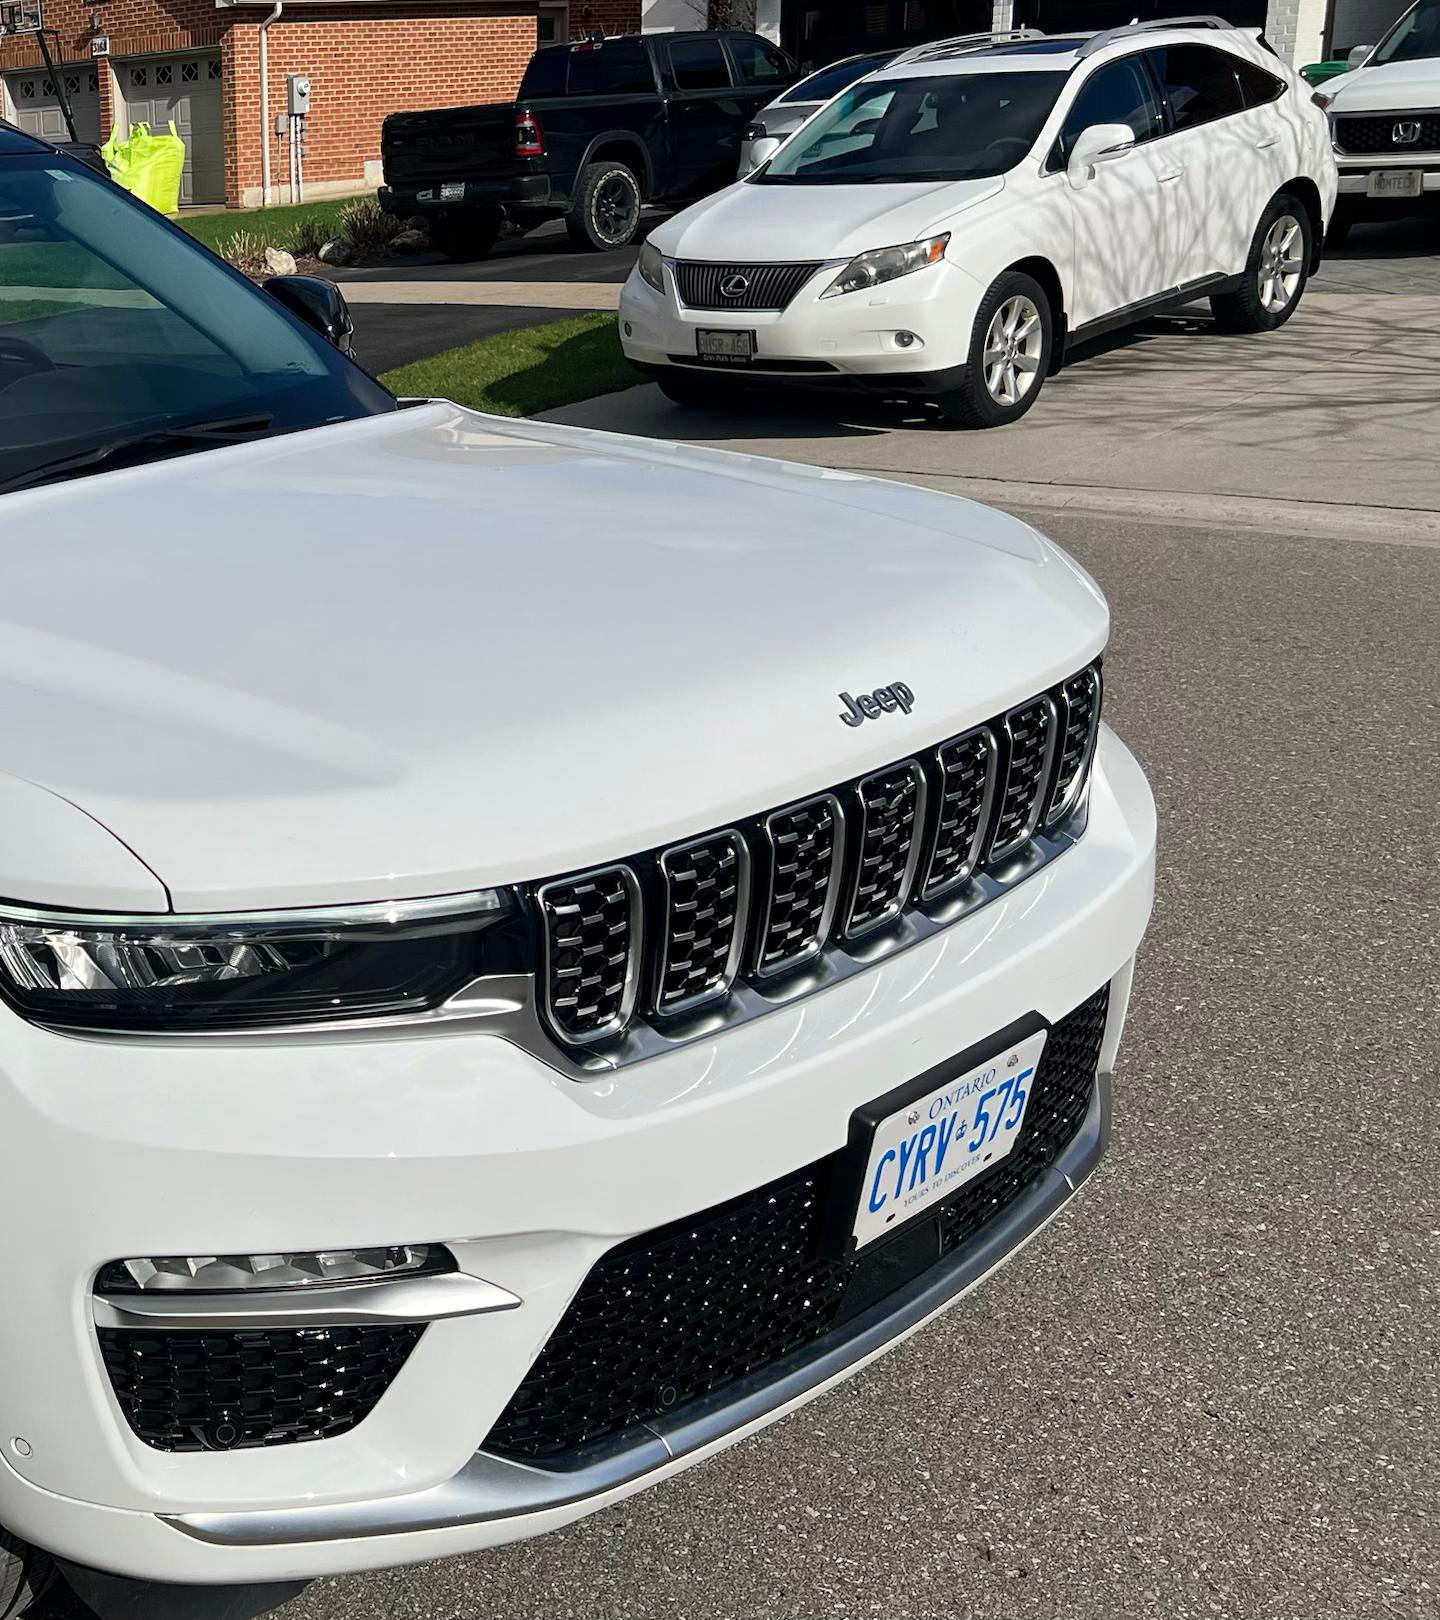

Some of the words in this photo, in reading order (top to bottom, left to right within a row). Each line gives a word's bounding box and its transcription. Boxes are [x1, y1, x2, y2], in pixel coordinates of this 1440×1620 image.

[838, 681, 915, 727] Jeep
[929, 1068, 996, 1119] ONTARIO
[869, 1111, 958, 1213] CYRV
[969, 1067, 1034, 1153] 575
[903, 1187, 929, 1208] YOURS
[932, 1177, 943, 1190] TO
[944, 1153, 981, 1183] DISCOVER
